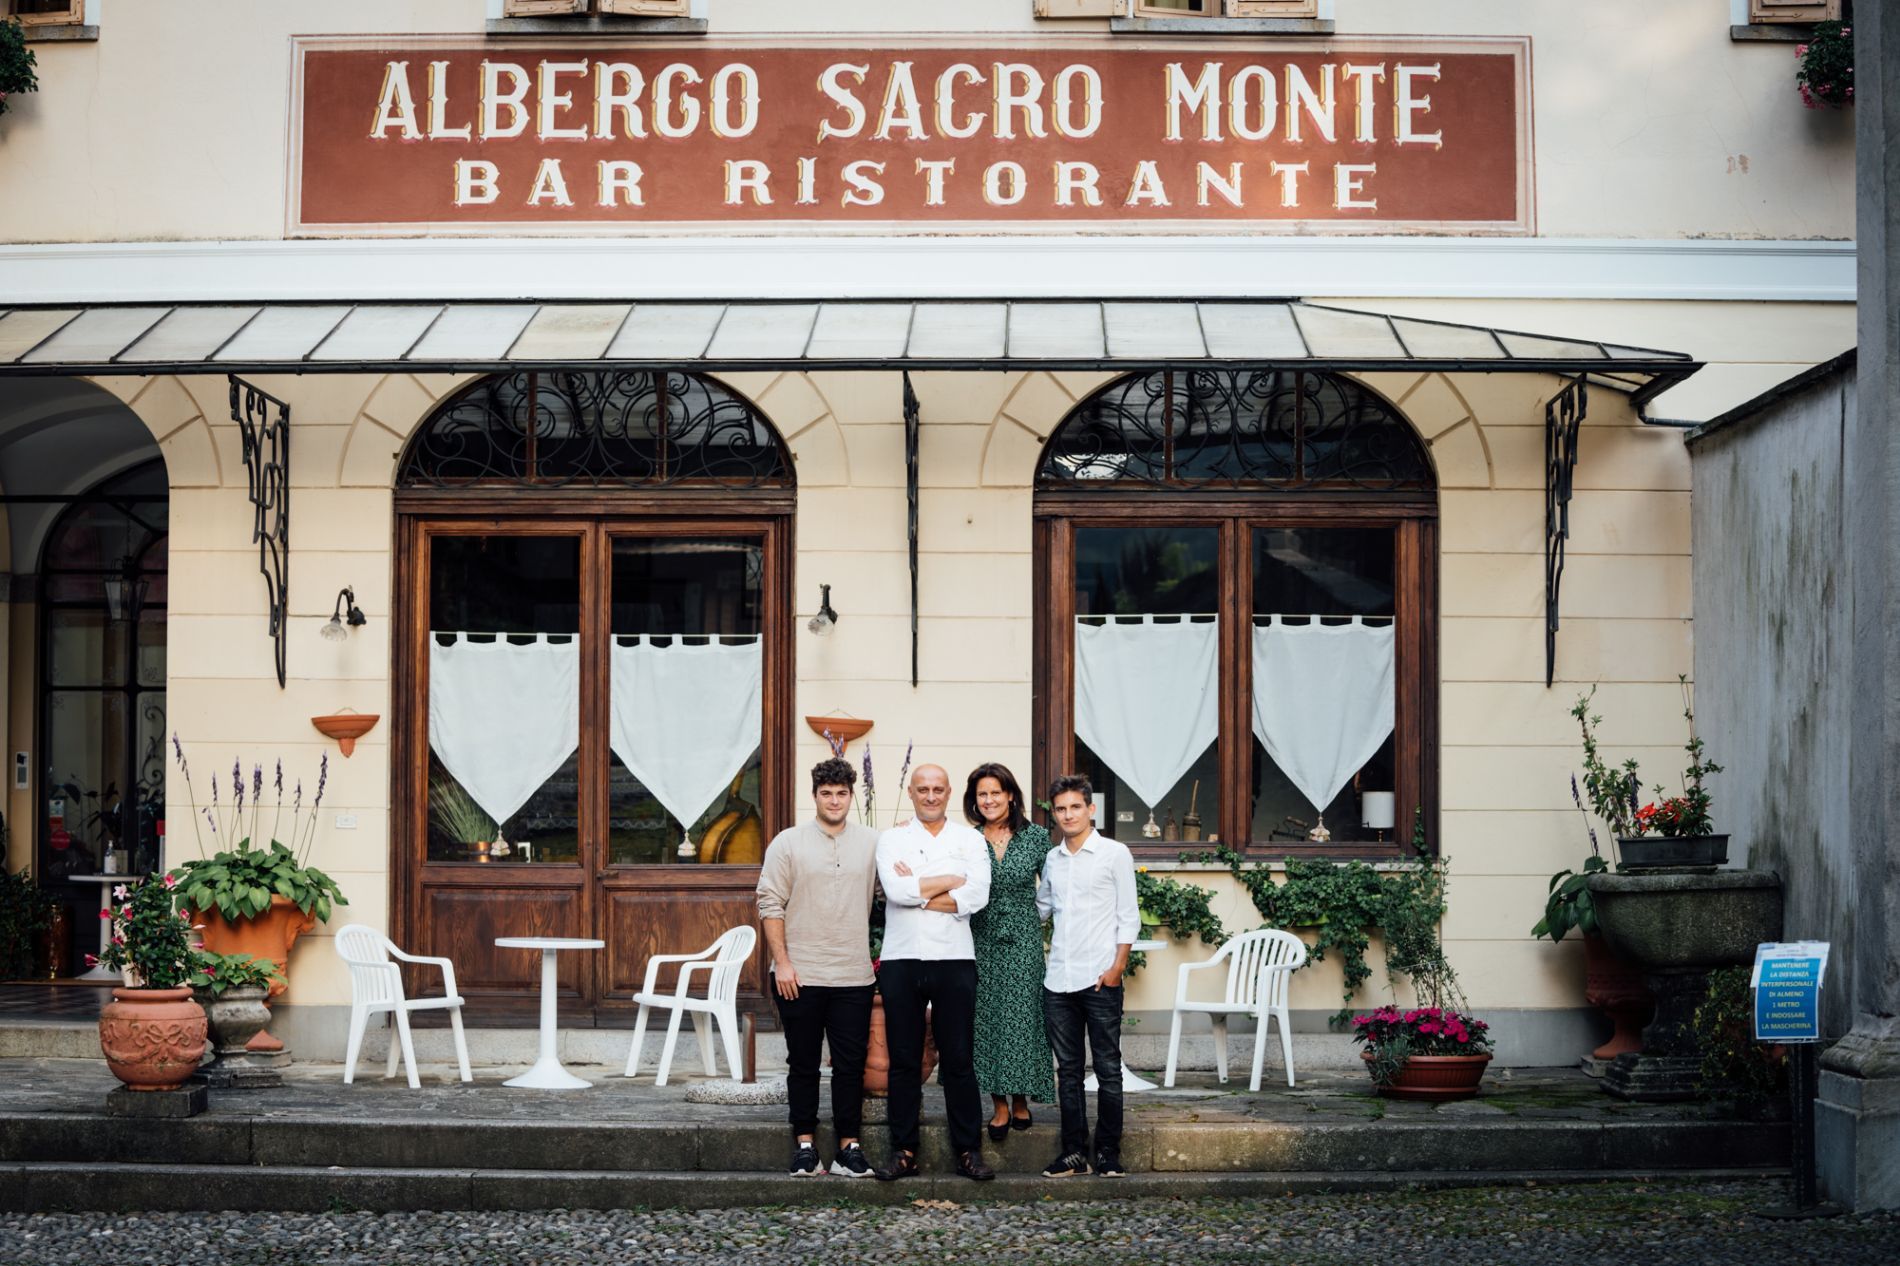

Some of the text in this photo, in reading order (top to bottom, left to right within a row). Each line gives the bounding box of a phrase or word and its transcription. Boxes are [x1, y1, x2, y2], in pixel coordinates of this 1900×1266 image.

[368, 58, 1444, 149] ALBERGO SACRO MONTE
[452, 157, 1379, 212] BAR RISTORANTE
